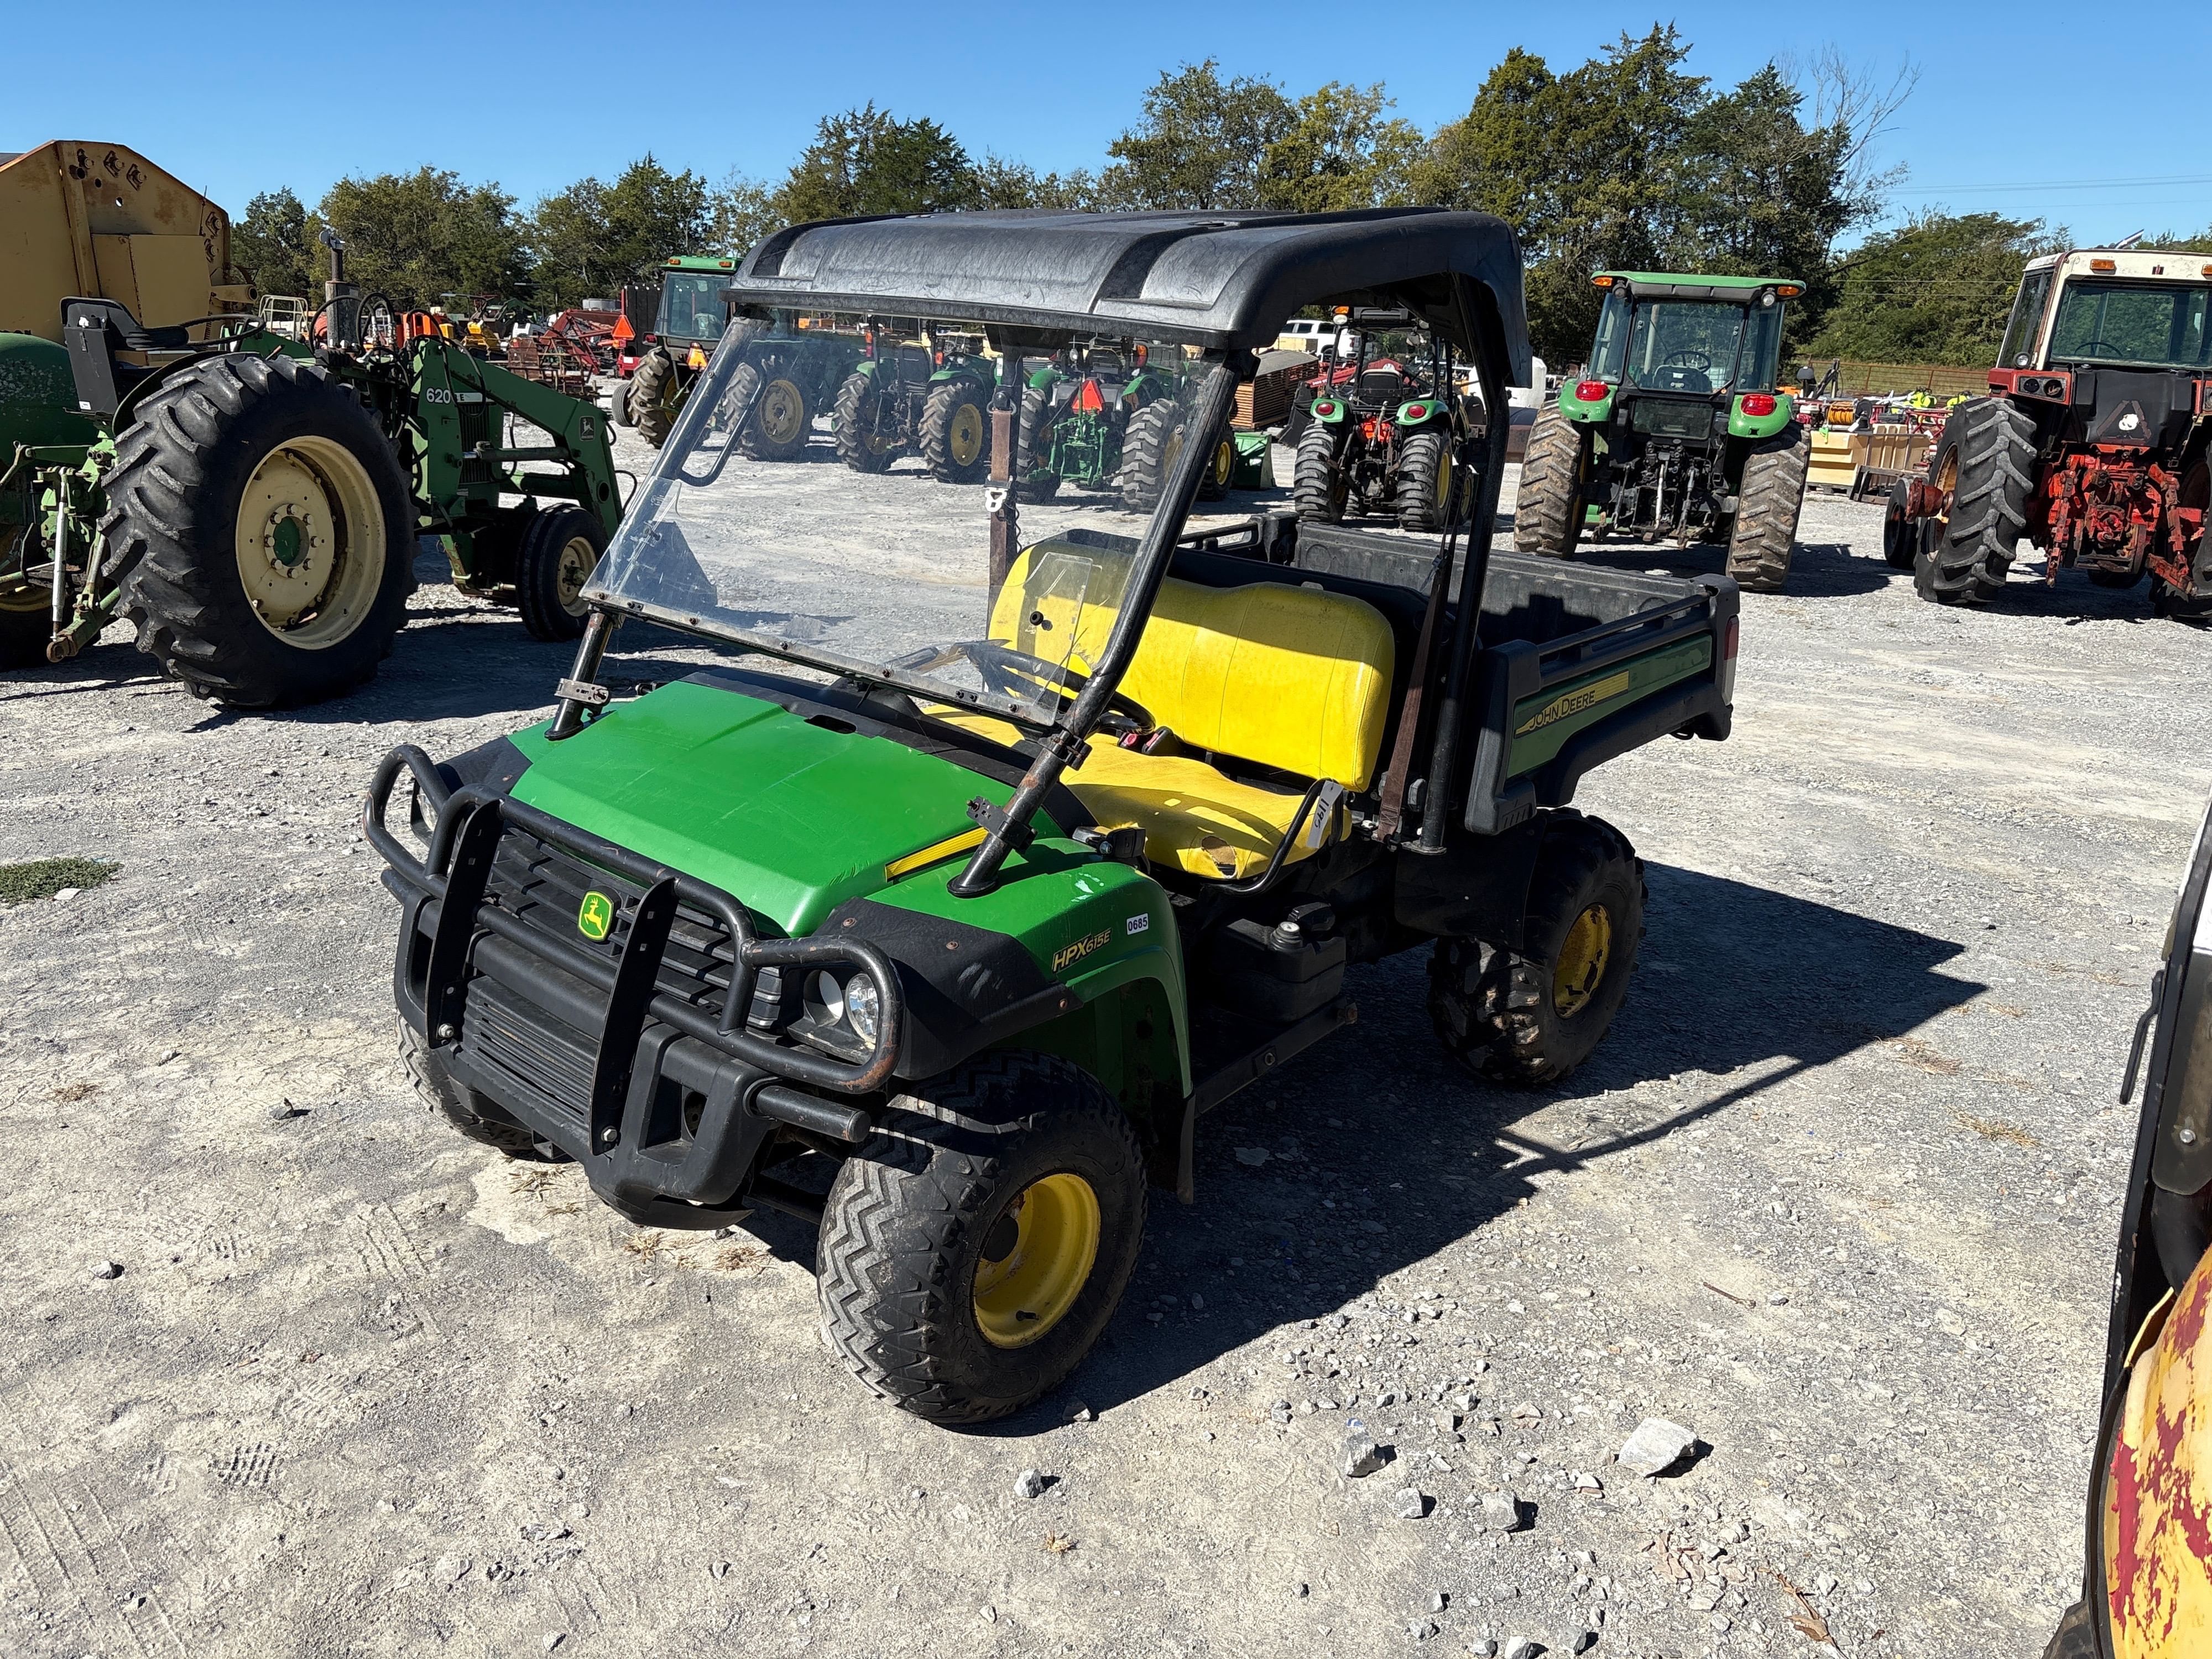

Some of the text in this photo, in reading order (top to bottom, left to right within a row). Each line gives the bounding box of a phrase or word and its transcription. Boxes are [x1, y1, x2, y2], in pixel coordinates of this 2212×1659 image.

[426, 388, 451, 404] 620
[1530, 691, 1595, 728] JOHN DEERE
[1315, 799, 1329, 828] 1195
[1128, 916, 1147, 931] 0685
